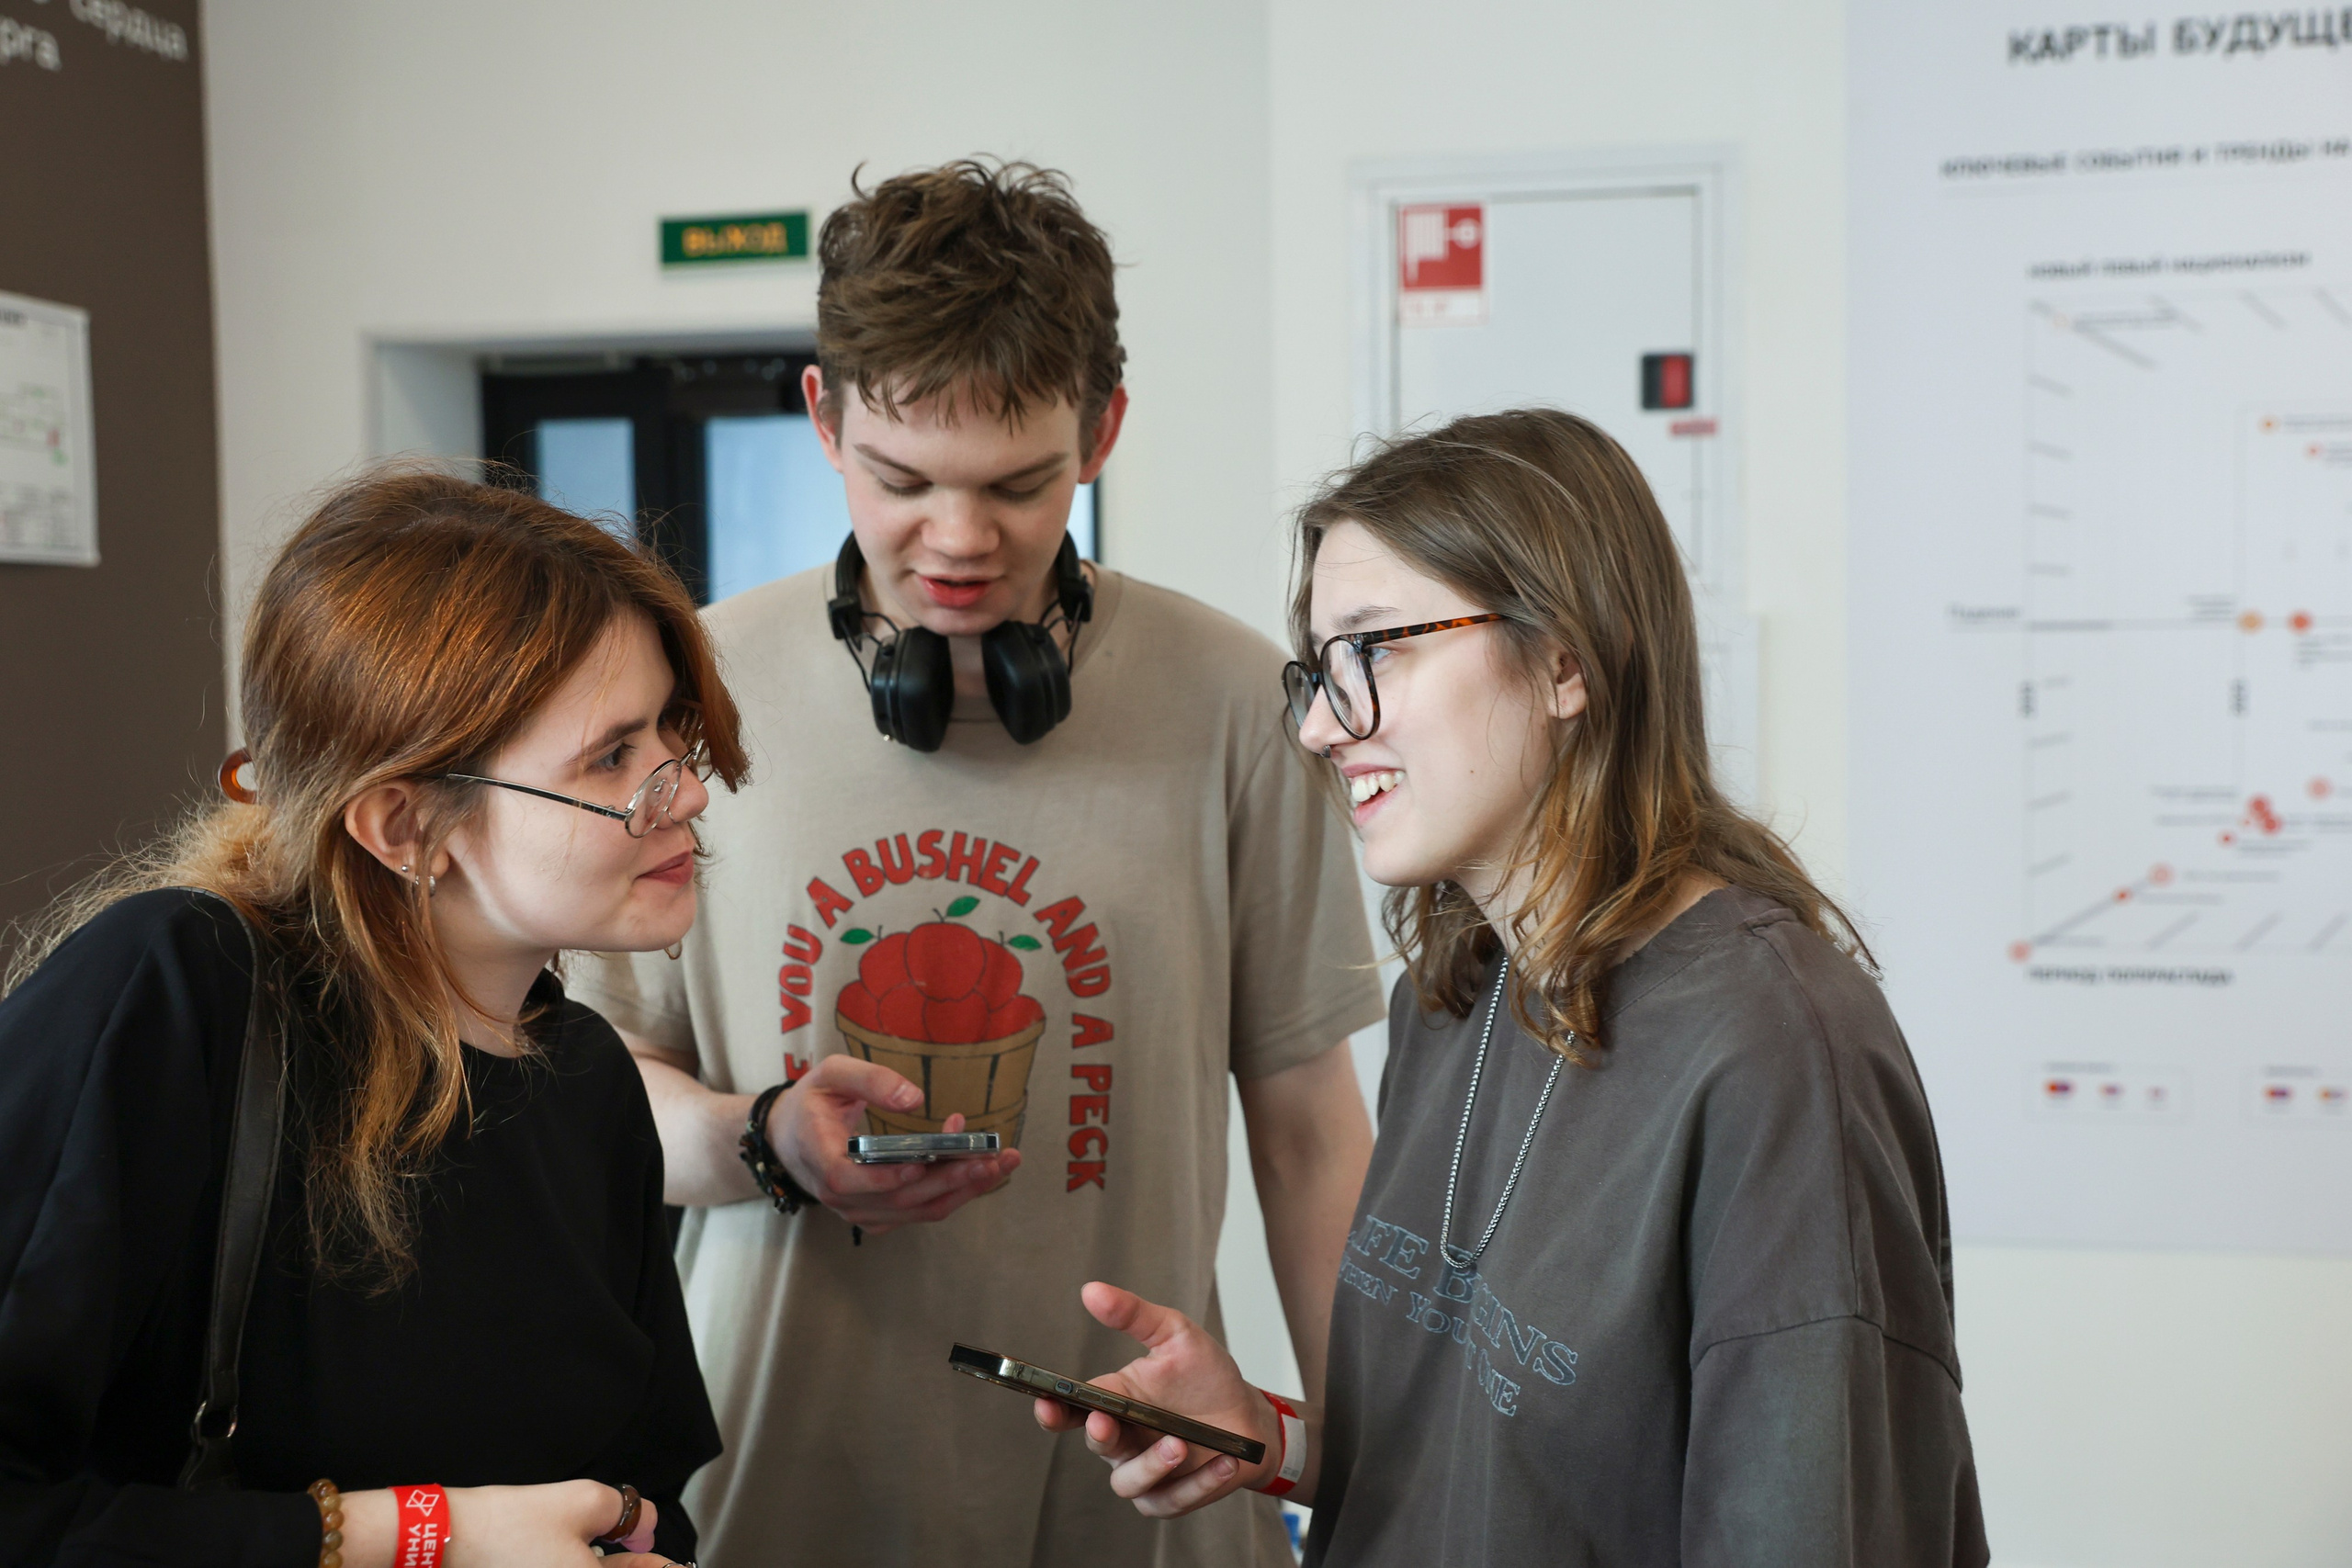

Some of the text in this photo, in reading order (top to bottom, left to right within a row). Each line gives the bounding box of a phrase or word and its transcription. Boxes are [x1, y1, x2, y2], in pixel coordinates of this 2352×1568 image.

[2007, 21, 2156, 66] КАРТЫ
[779, 829, 1114, 1193] YOU A BUSHEL AND A PECK
[1433, 1244, 1578, 1386] BGINS
[404, 1522, 422, 1568] УНИ
[421, 1523, 438, 1568] ЦЕН
